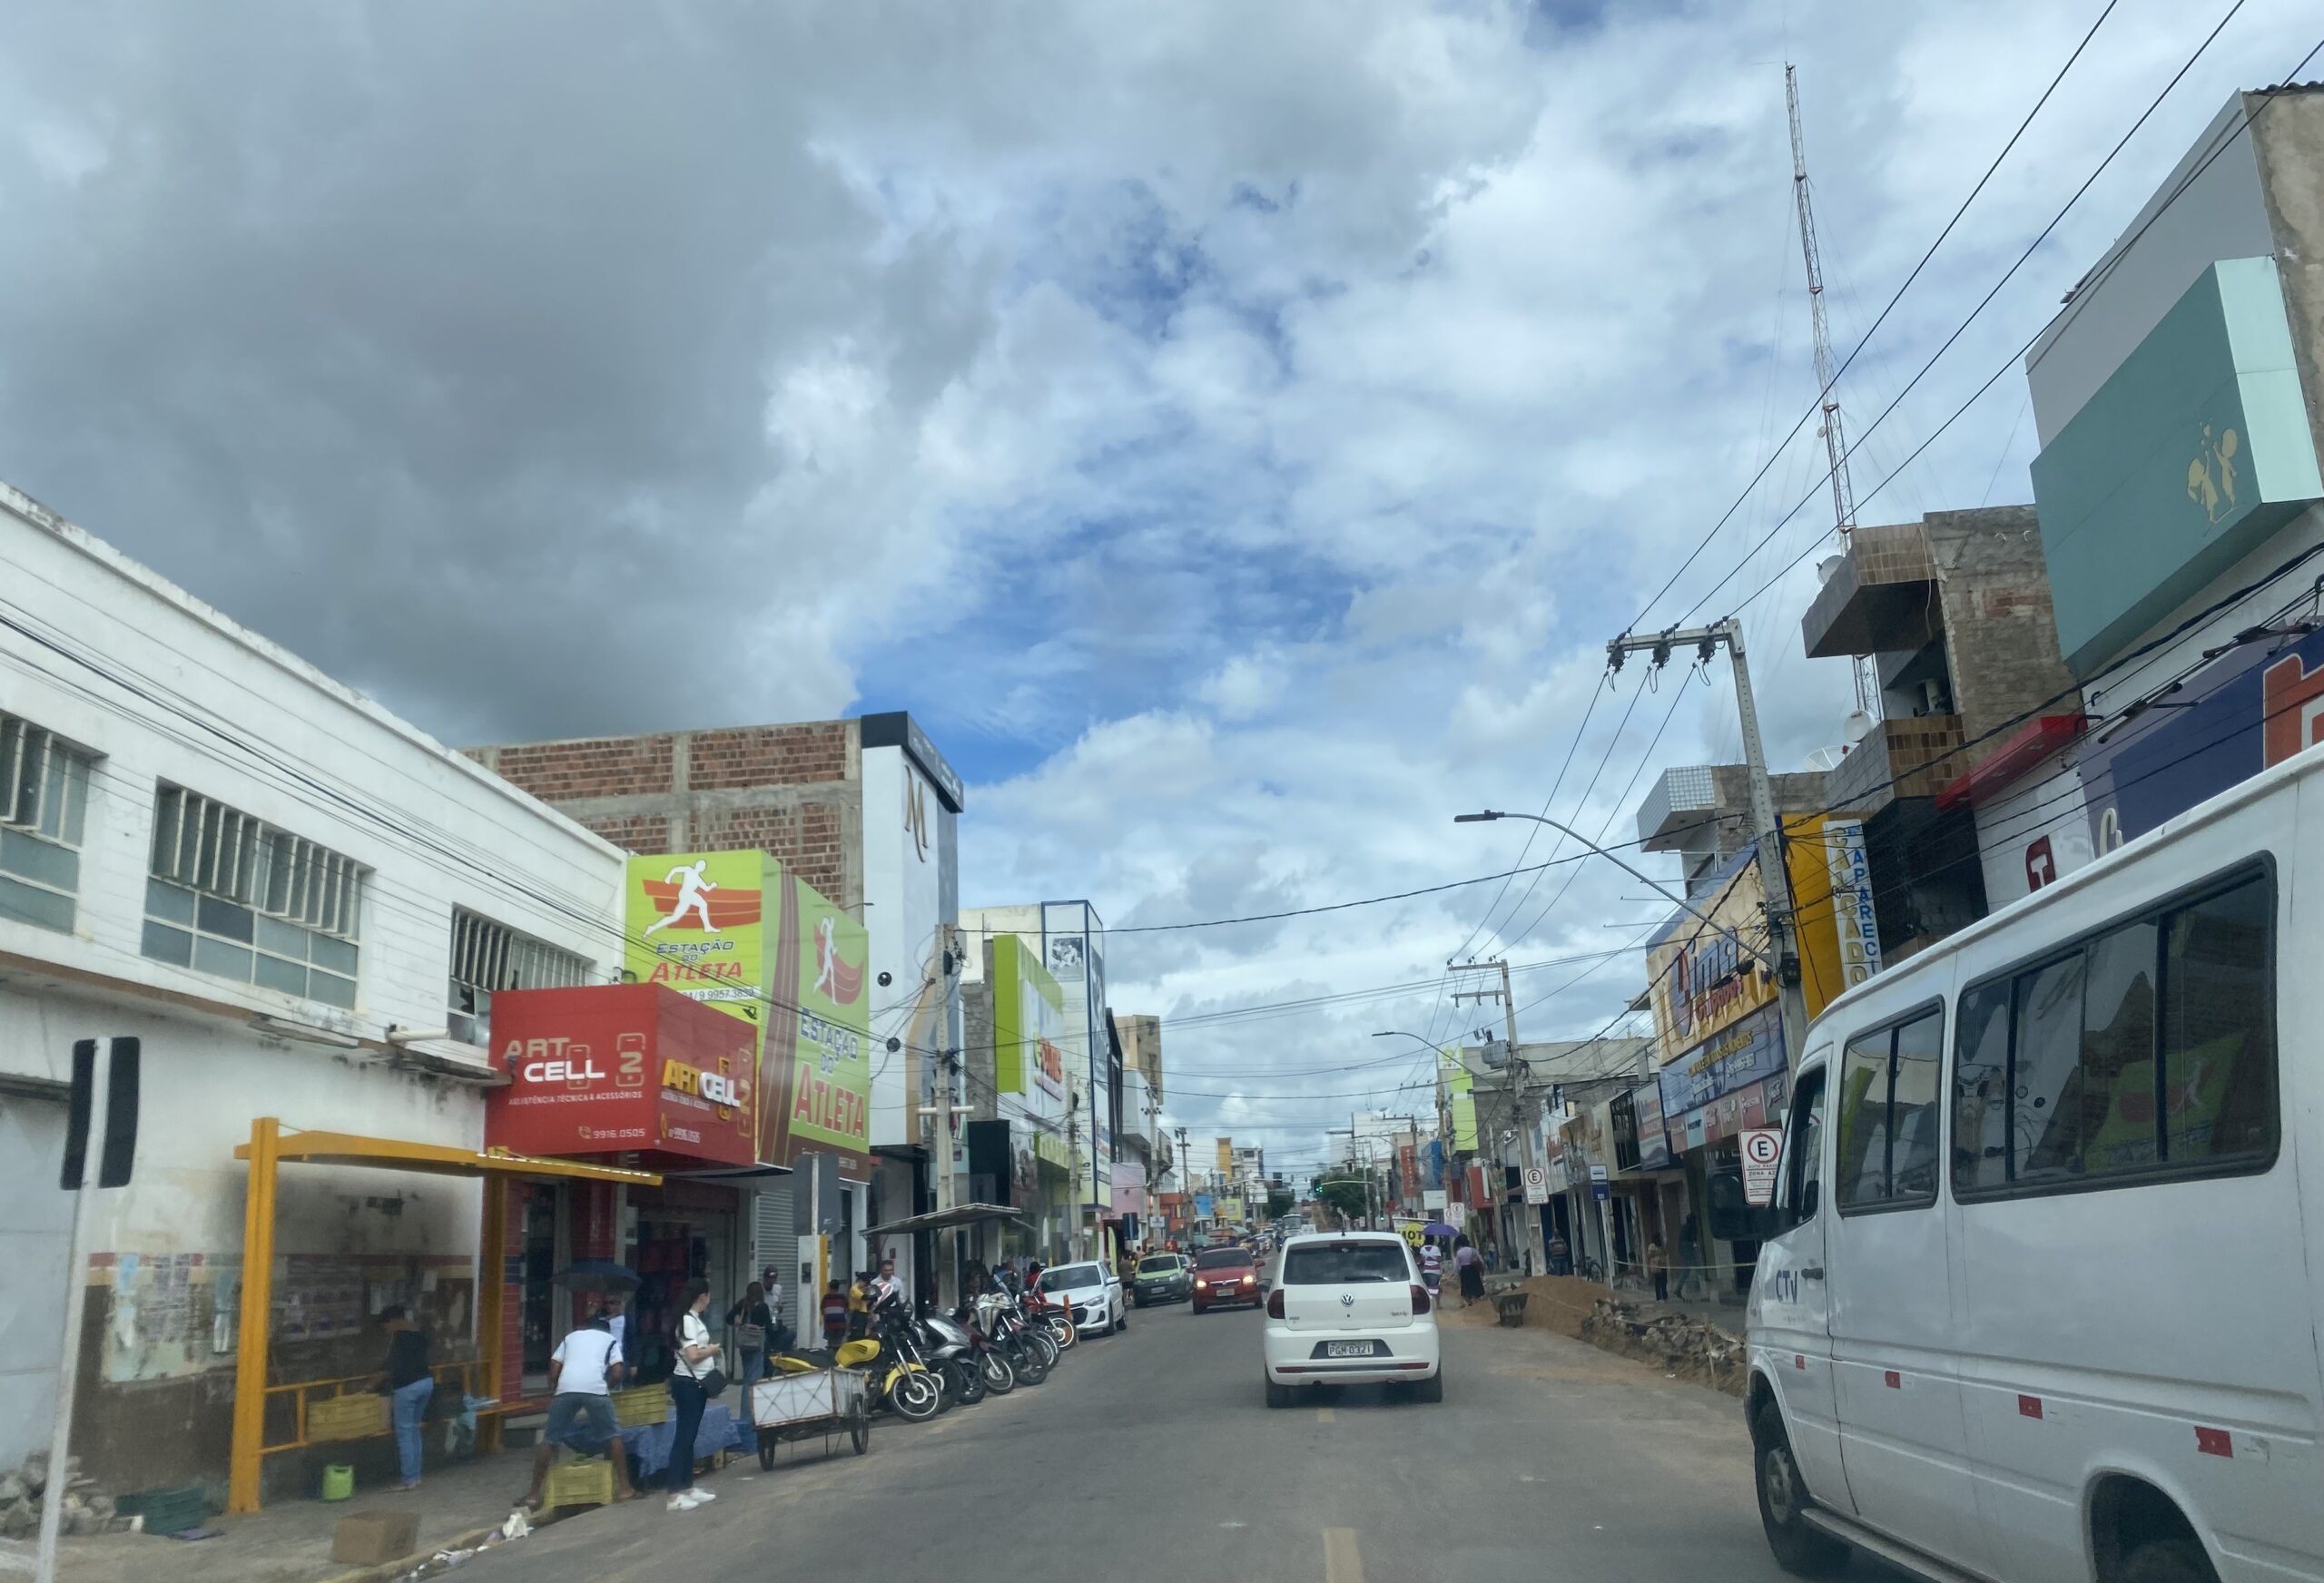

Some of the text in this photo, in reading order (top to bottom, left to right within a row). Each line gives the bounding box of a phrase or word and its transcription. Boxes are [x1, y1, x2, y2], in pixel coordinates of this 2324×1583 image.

[656, 939, 734, 954] ESTAÇÃO
[647, 961, 743, 983] ATLETA
[800, 1006, 859, 1062] ESTAÇÃO
[502, 1037, 570, 1059] ART
[523, 1058, 606, 1083] CELL
[820, 1052, 834, 1075] DO
[556, 1092, 588, 1103] TÉCNICA
[596, 1090, 643, 1101] ACESSÓRIOS
[793, 1061, 865, 1141] ATLETA
[1758, 1140, 1769, 1157] E
[1531, 1172, 1538, 1181] E
